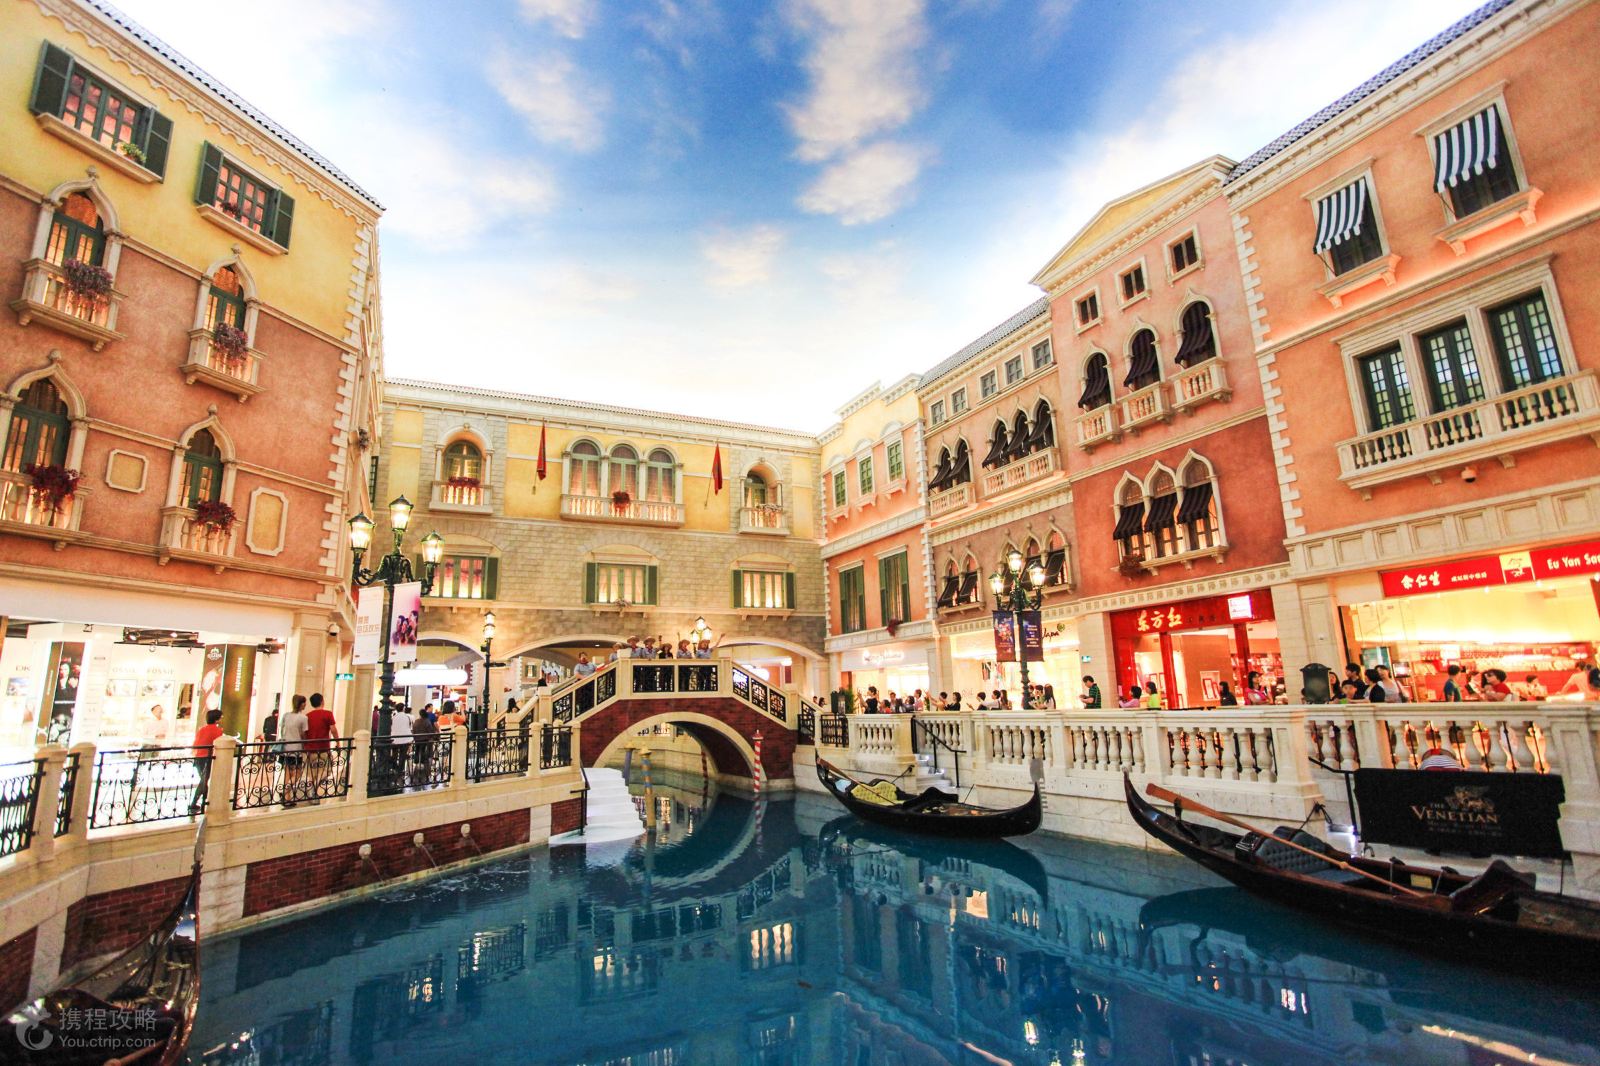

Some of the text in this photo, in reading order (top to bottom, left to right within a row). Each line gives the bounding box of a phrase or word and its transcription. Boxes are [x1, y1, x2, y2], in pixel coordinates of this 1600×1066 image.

[1547, 558, 1560, 571] Eu
[1562, 556, 1581, 569] Yan
[1401, 571, 1441, 590] 余仁生
[1411, 805, 1498, 824] VENETIAN
